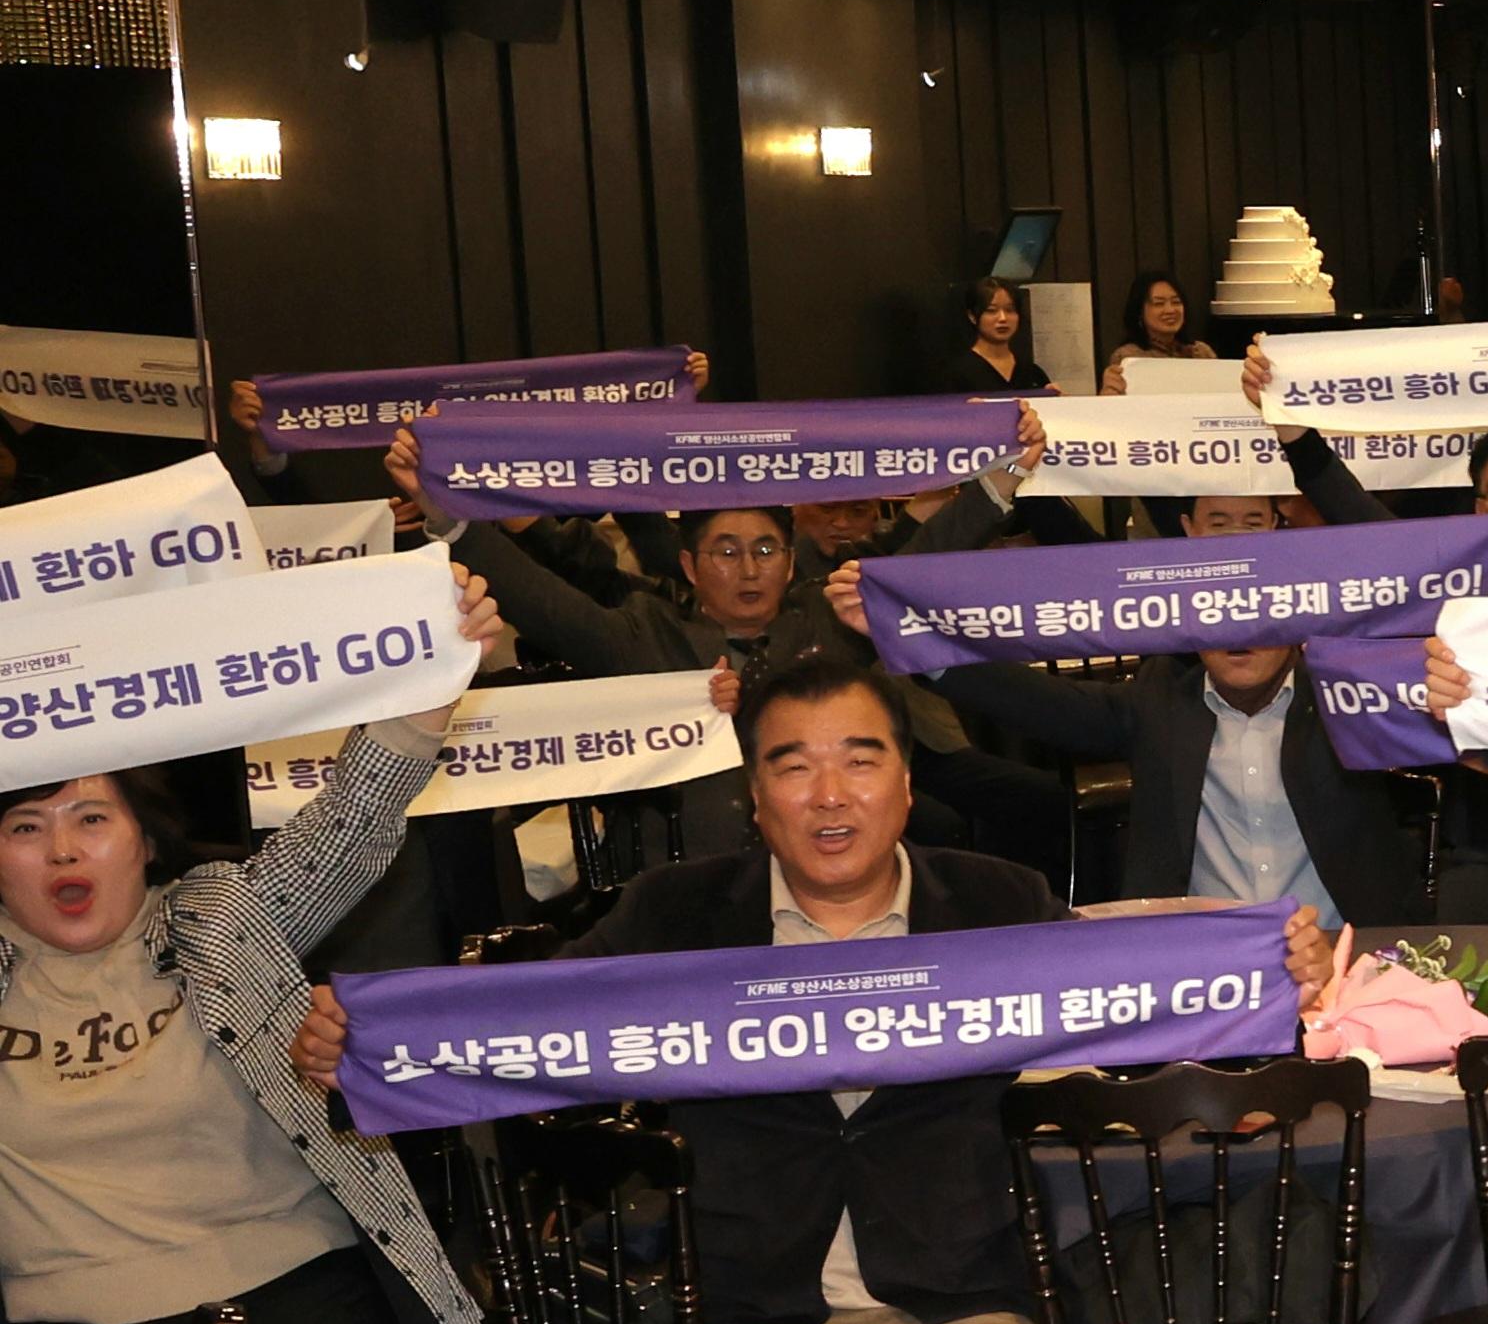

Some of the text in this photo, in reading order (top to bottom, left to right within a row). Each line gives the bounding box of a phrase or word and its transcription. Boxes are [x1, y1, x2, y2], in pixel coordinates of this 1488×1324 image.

[583, 379, 674, 403] 환하 GO!
[1284, 377, 1394, 406] 소상공인
[1404, 373, 1460, 399] 흥하
[448, 448, 938, 489] 소상공인 흥하 GO! 양산경제 환하
[32, 539, 135, 593] 환하
[151, 521, 241, 567] GO!
[900, 565, 1482, 637] 소상공인 흥하 GO! 양산경제 환하 GO!
[0, 620, 434, 739] 양산경제 환하 GO!
[383, 971, 1262, 1082] 소상공인 흥하 GO! 양산경제 환하 GO!
